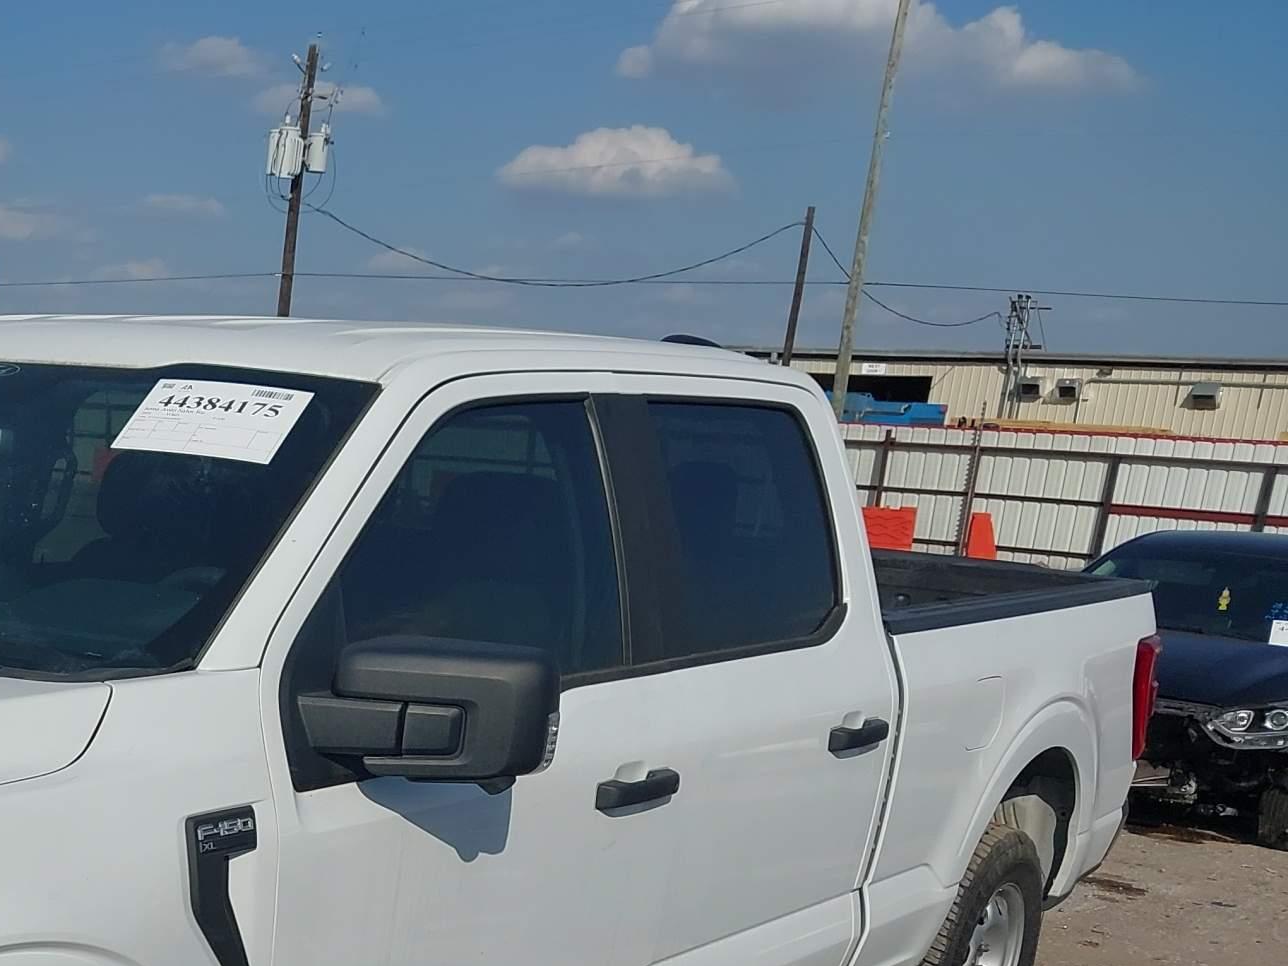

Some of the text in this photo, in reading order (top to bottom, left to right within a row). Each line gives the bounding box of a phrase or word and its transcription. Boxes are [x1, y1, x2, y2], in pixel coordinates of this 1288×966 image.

[158, 394, 285, 418] 44384175
[197, 817, 254, 841] F-150
[201, 841, 217, 852] XL
